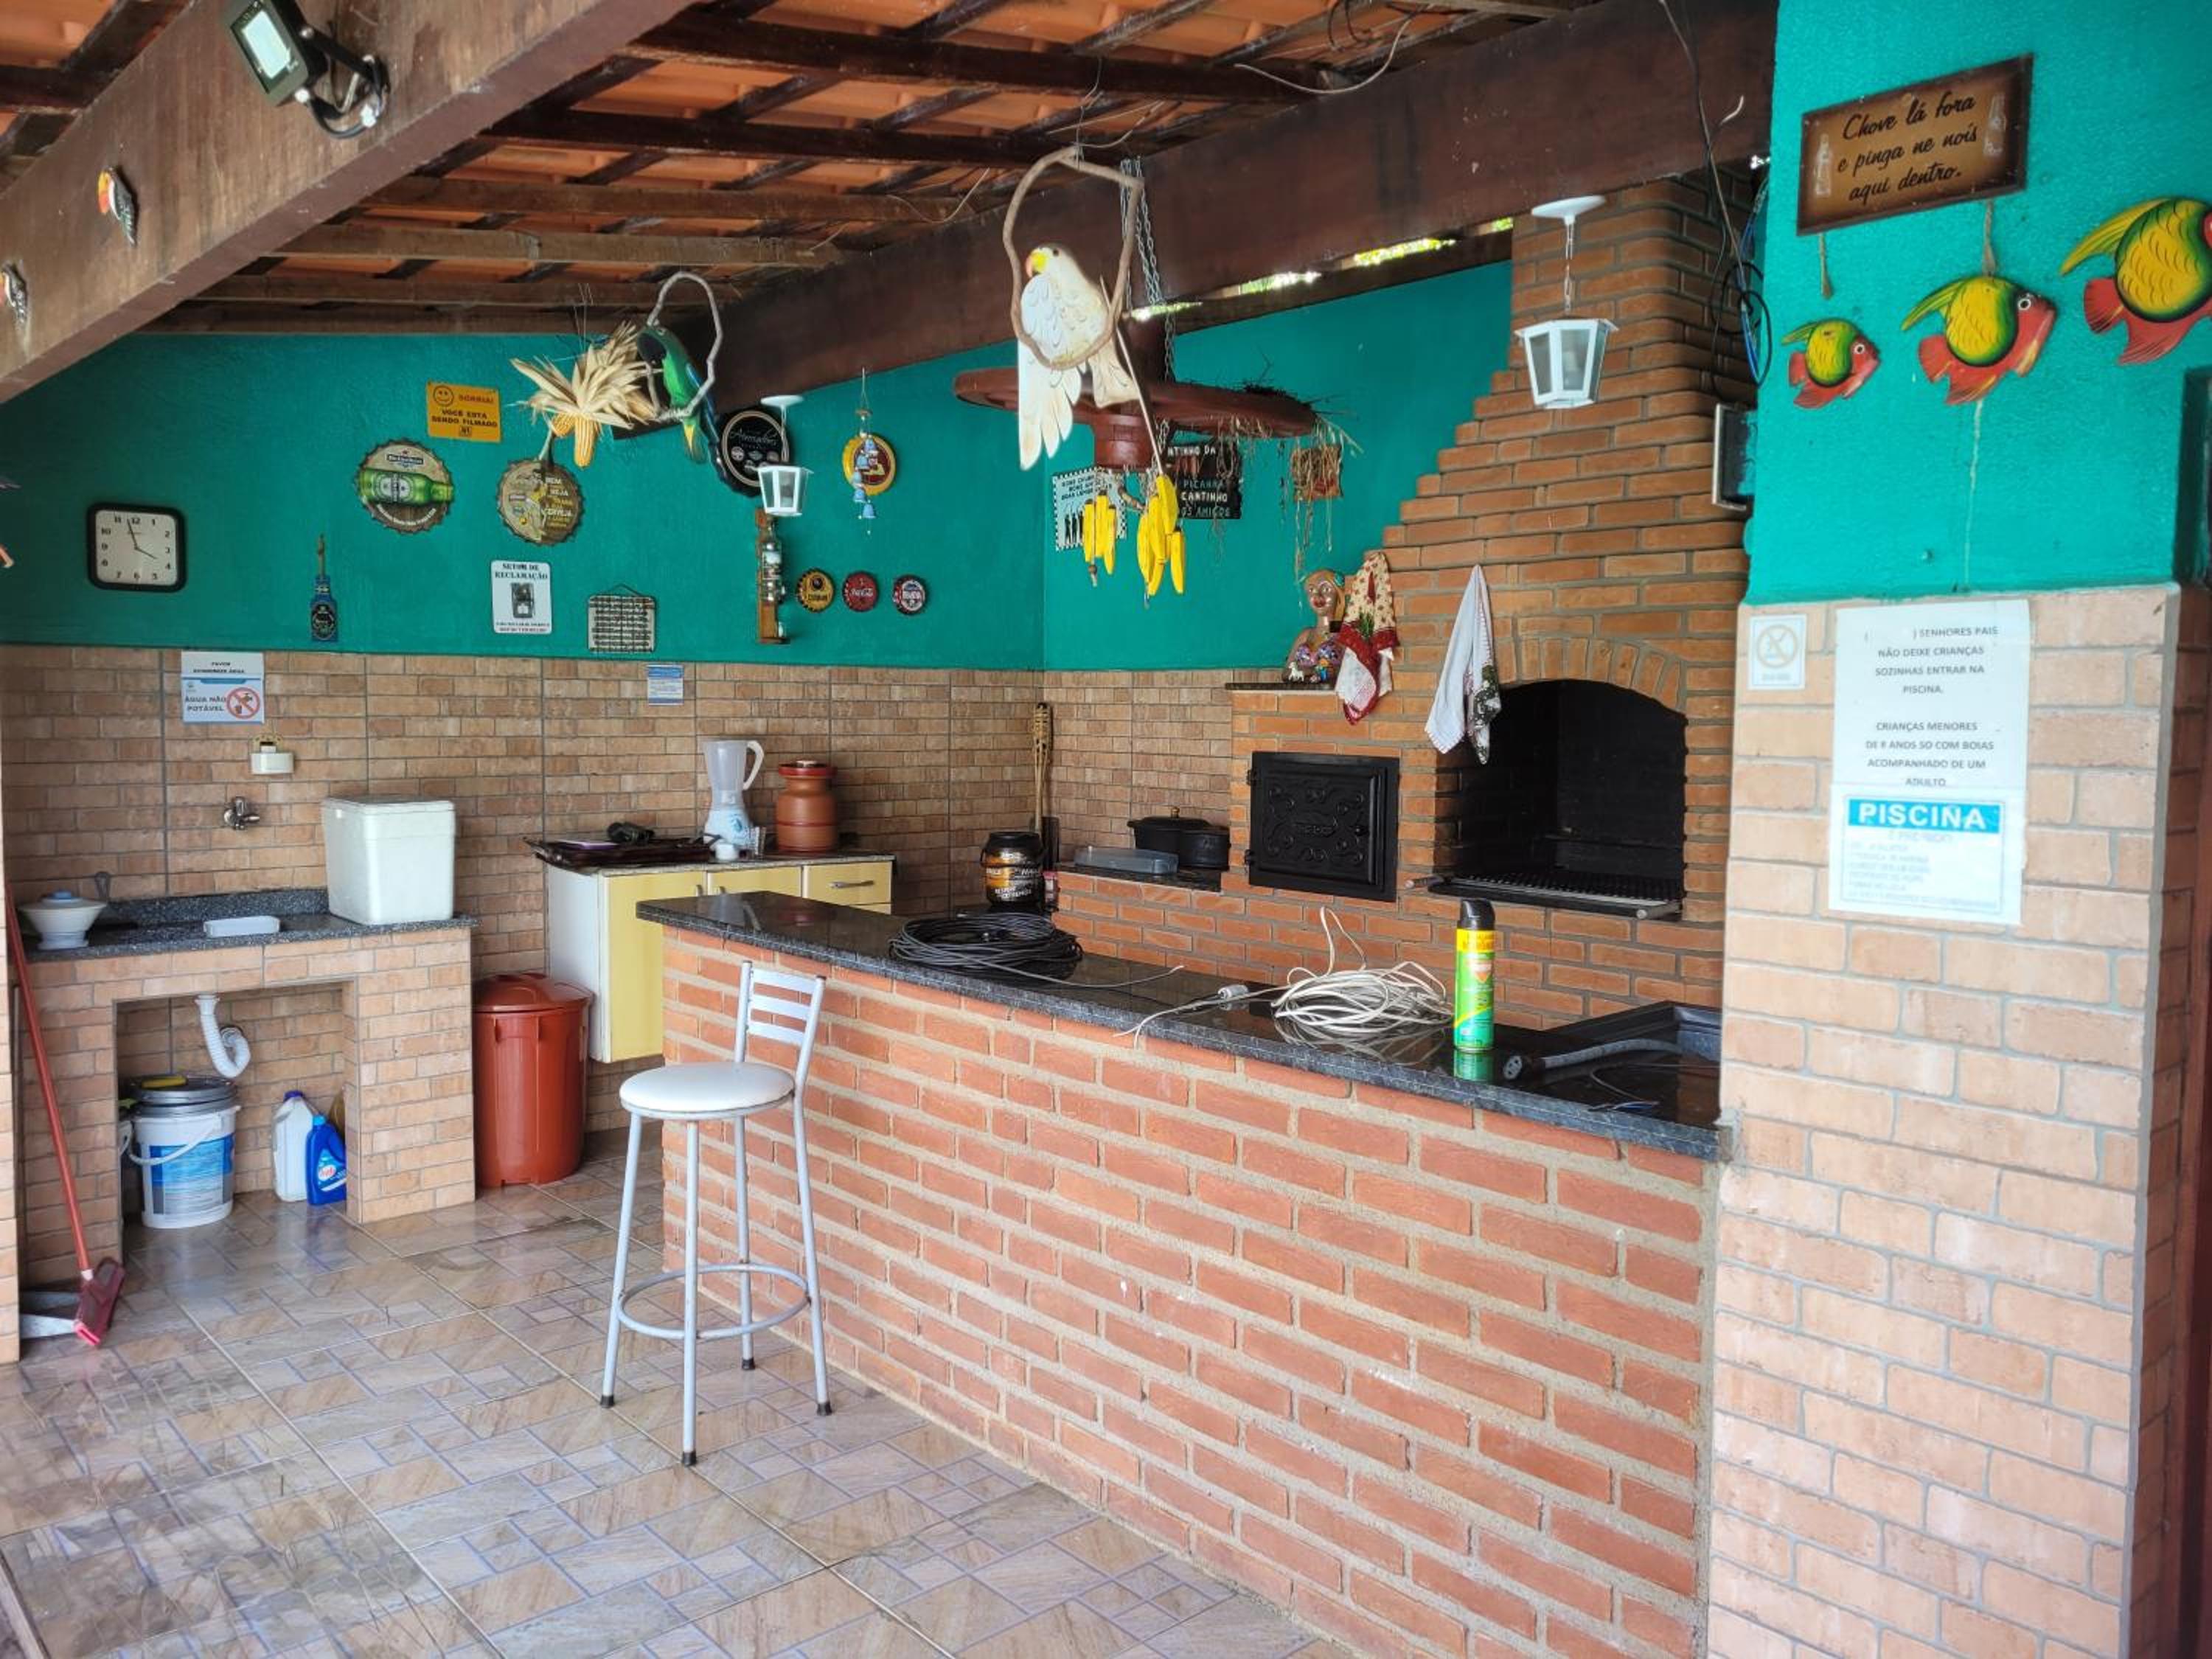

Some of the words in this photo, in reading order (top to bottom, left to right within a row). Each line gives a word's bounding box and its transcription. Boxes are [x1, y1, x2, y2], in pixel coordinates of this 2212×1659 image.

[1843, 114, 1897, 139] Chove
[1906, 97, 1927, 125] lá
[1935, 91, 1976, 119] fora
[1837, 158, 1848, 173] e
[1852, 145, 1905, 178] pinga
[1912, 137, 1935, 154] ne
[1848, 177, 1891, 206] aqui
[1897, 162, 1961, 190] dentro.
[463, 418, 498, 427] FILMADO
[1180, 492, 1228, 502] CANTINHO
[495, 571, 548, 580] RECLAMAÇÃO
[1919, 627, 1972, 639] SENHORES
[1975, 625, 1999, 636] PAIS
[1878, 646, 1900, 658] NÃO
[1903, 647, 1929, 657] DEIXE
[1933, 646, 1984, 658] CRIANÇAS
[1875, 667, 1924, 677] SOZINHAS
[1927, 665, 1966, 675] ENTRAR
[1969, 664, 1984, 674] NA
[1902, 685, 1944, 695] PISCINA.
[1876, 722, 1924, 733] CRIANÇAS
[1927, 722, 1978, 731] MENORES
[1865, 740, 1877, 750] DE
[1889, 740, 1916, 750] ANOS
[1935, 740, 1959, 750] COM
[1961, 741, 1994, 751] BOIAS
[1867, 758, 1948, 768] ACOMPANHADO
[1951, 759, 1965, 769] DE
[1967, 759, 1986, 769] UM
[1905, 778, 1946, 787] ADULTO
[1858, 801, 1986, 830] PISCINA
